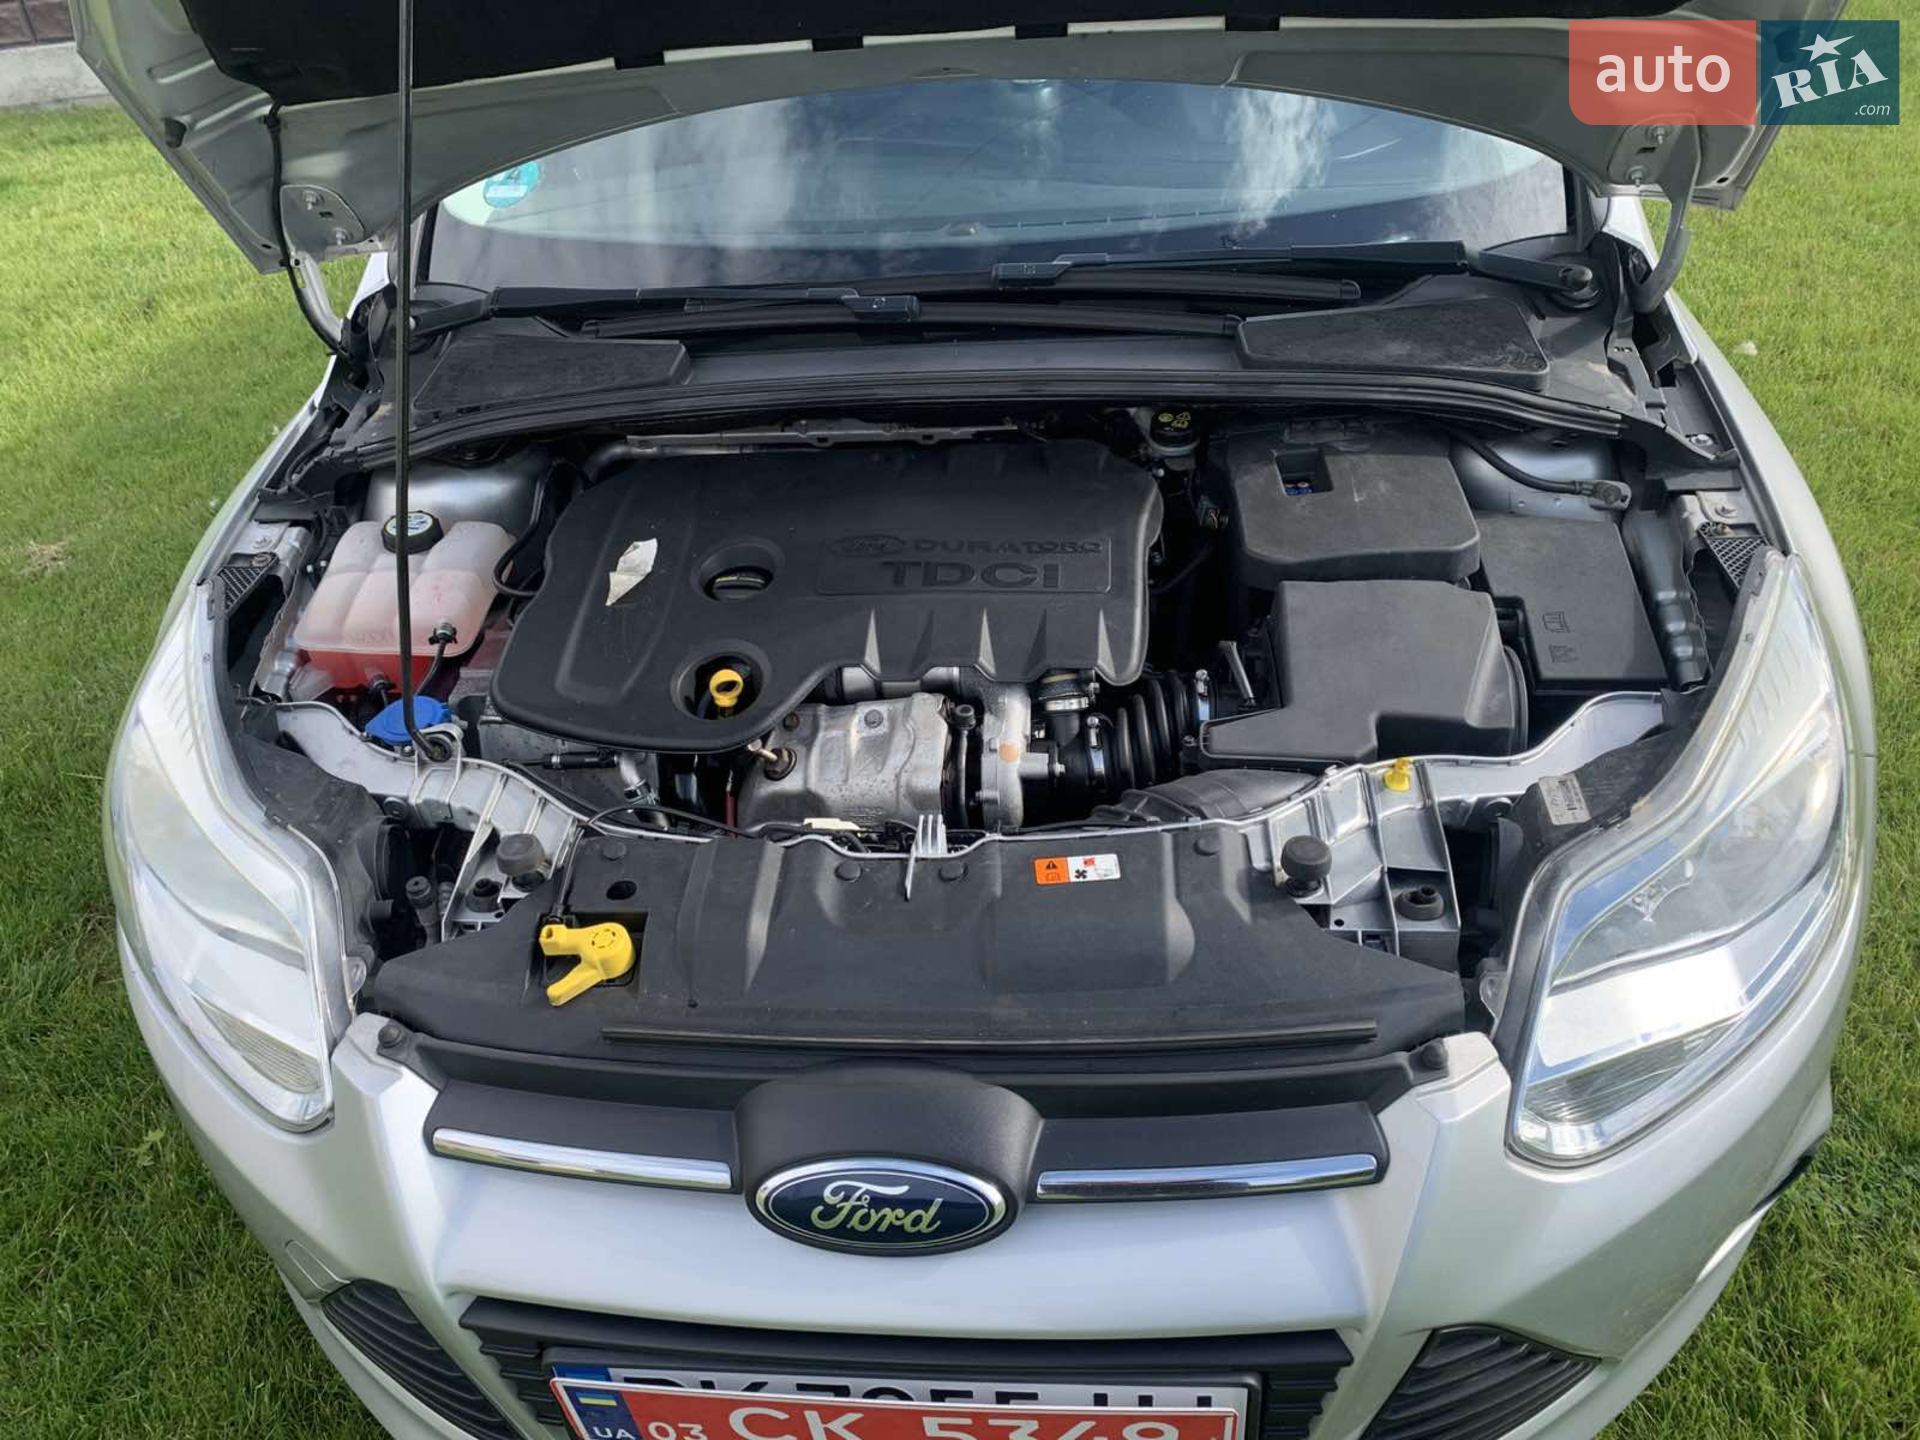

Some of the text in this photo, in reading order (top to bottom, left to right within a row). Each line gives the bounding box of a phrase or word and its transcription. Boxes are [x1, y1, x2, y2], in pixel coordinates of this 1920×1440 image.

[810, 1180, 943, 1234] Ford
[593, 1426, 636, 1440] UA
[729, 1406, 865, 1440] CK
